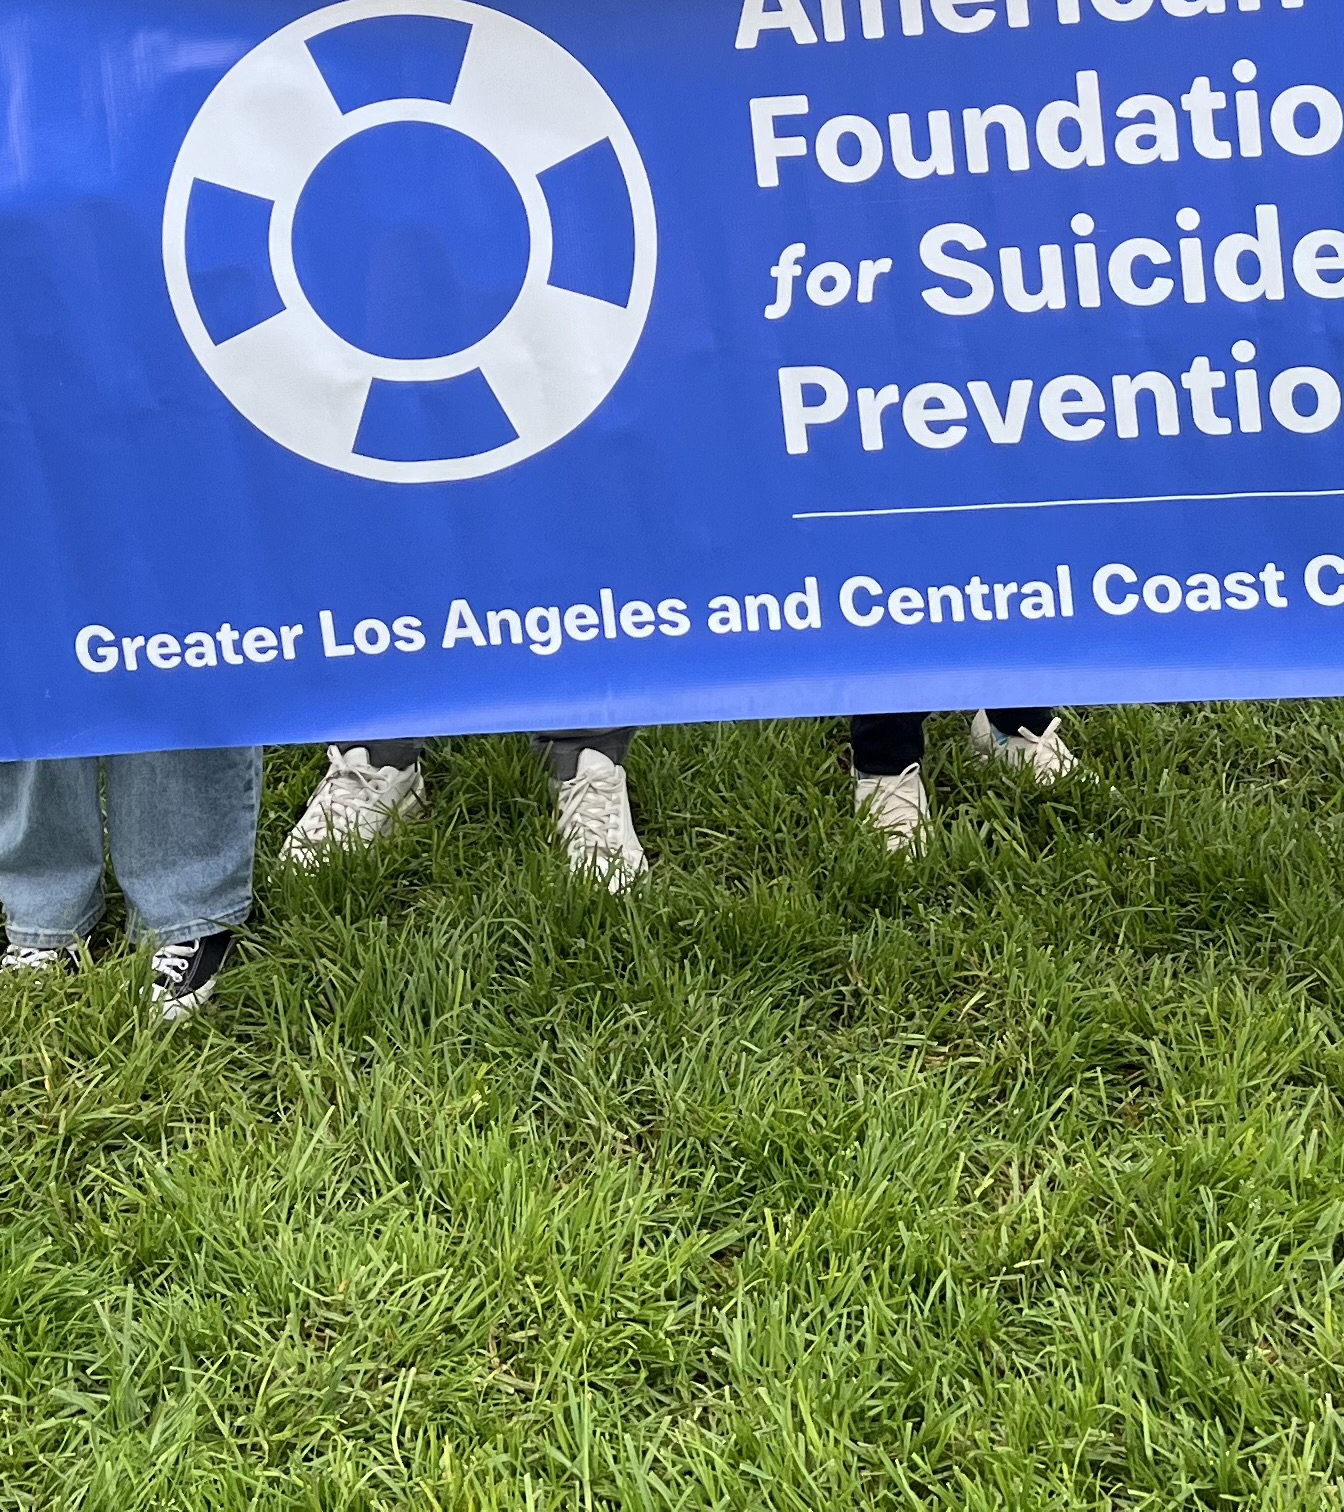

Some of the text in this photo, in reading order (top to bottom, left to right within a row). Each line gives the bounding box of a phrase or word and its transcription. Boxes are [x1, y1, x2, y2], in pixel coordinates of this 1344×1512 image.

[764, 242, 893, 320] for
[75, 622, 304, 673] Greater
[319, 609, 426, 658] Los
[441, 588, 691, 656] Angeles
[707, 576, 822, 634] and
[839, 564, 1074, 627] Central
[1092, 562, 1288, 616] Coast
